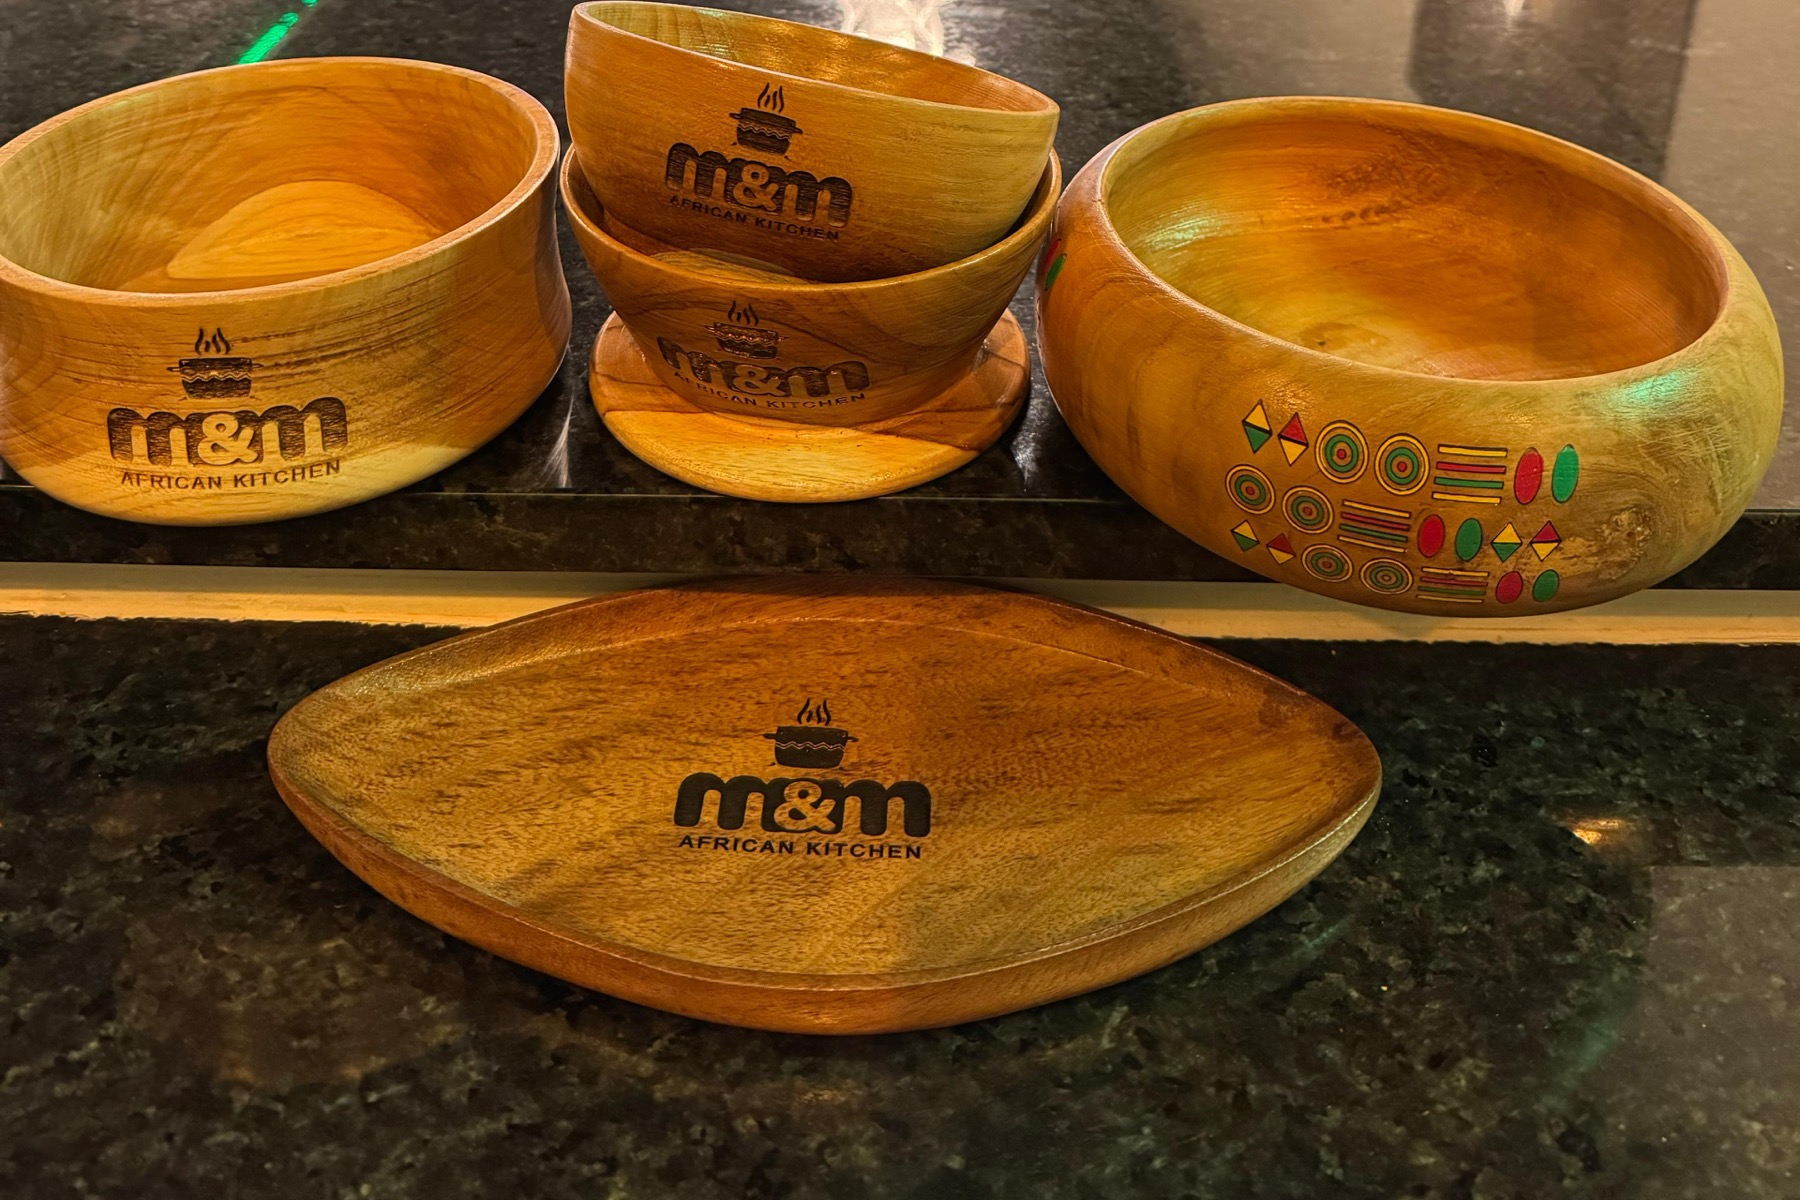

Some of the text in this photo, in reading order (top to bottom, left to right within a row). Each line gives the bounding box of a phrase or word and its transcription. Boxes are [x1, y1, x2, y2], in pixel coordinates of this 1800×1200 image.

[665, 141, 853, 227] m&m
[669, 195, 839, 241] AFRICAN KITCHEN
[657, 336, 871, 397] m&m
[673, 371, 865, 409] AFRICAN KITCHEN
[107, 396, 348, 466] m&m
[121, 460, 341, 490] AFRICAN KITCHEN
[674, 771, 932, 837] m&m
[678, 834, 922, 859] AFRICAN KITCHEN
